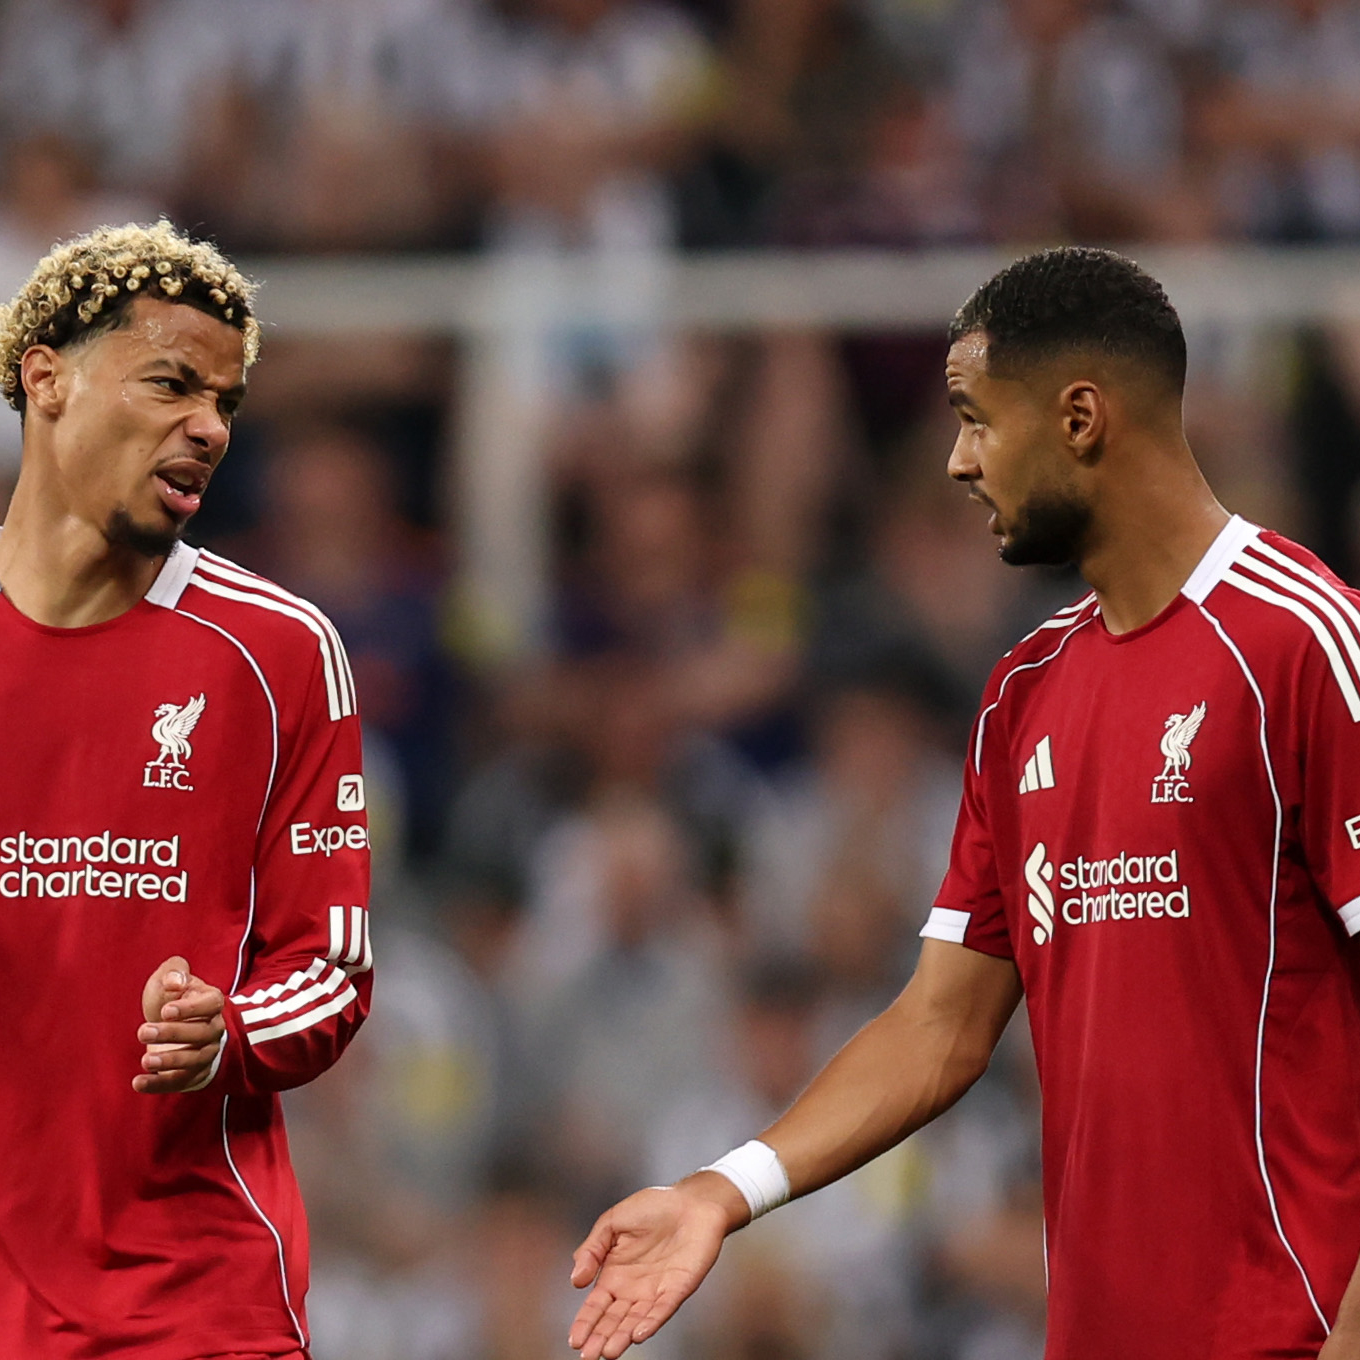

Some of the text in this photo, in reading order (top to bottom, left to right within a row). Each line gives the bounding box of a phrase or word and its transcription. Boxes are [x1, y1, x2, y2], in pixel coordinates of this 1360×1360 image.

[143, 767, 194, 791] L.F.C.
[1150, 782, 1194, 803] L.F.C.
[0, 830, 179, 868] standard
[290, 822, 370, 857] Expe
[0, 864, 188, 903] chartered
[1059, 849, 1179, 890] standard
[1061, 885, 1190, 925] chartered
